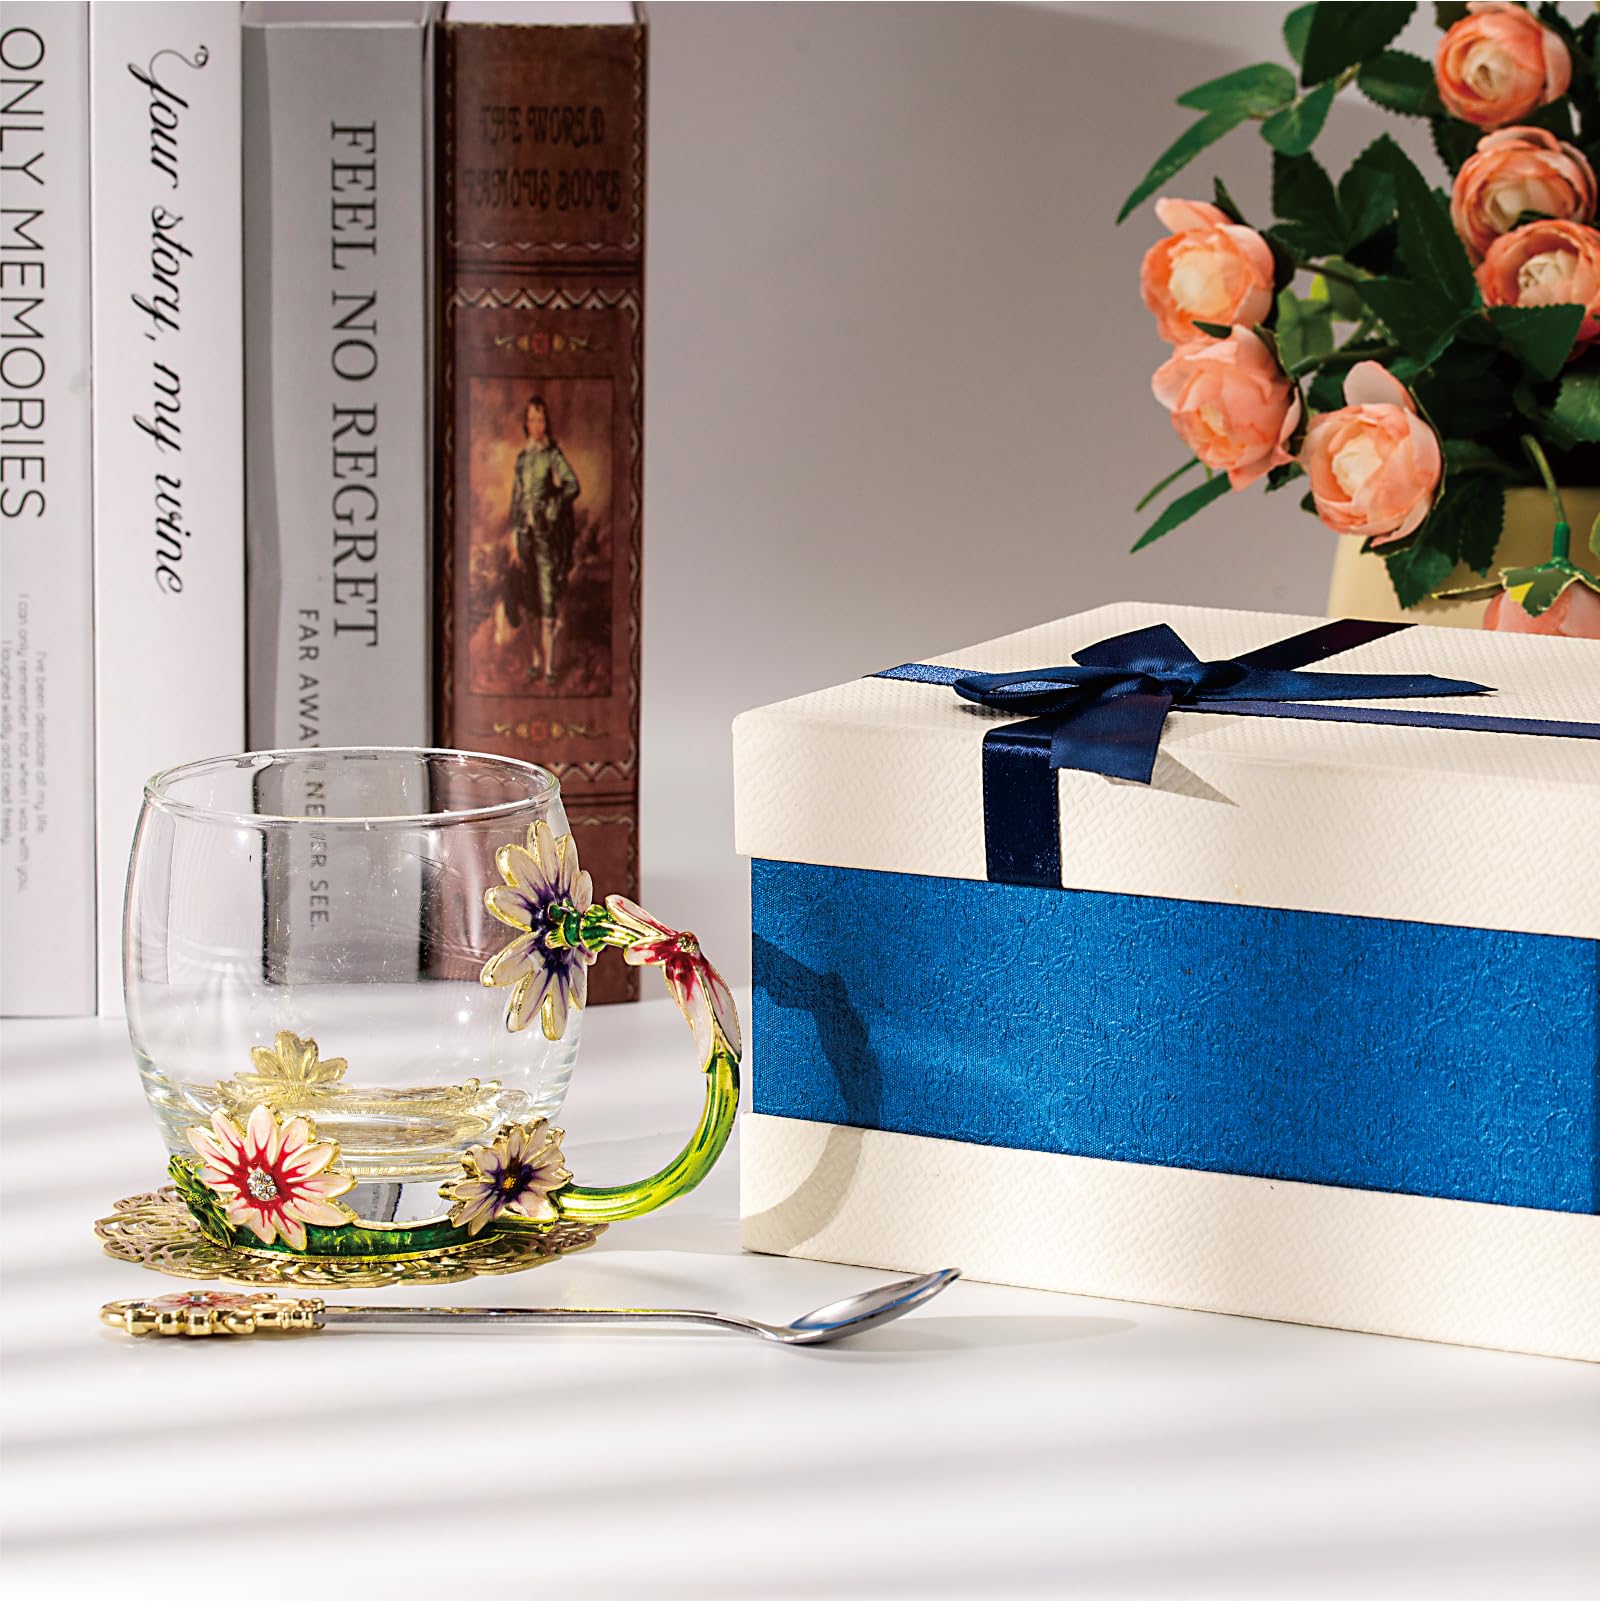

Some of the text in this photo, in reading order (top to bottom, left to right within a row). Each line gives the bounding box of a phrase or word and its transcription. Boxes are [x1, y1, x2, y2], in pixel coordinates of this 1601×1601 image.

[479, 105, 605, 148] THE WORLD
[0, 27, 46, 519] ONLY MEMORIES
[130, 205, 193, 341] story,
[132, 361, 182, 454] my
[329, 120, 379, 647] FEEL NO REGRET
[153, 473, 191, 594] wine
[18, 601, 29, 625] can
[298, 608, 320, 661] FAR
[16, 629, 31, 656] only
[18, 660, 30, 726] remember
[35, 677, 47, 707] been
[1, 744, 12, 768] and
[18, 731, 30, 757] that
[35, 712, 47, 766] desolate
[18, 762, 30, 796] when
[33, 790, 46, 809] my
